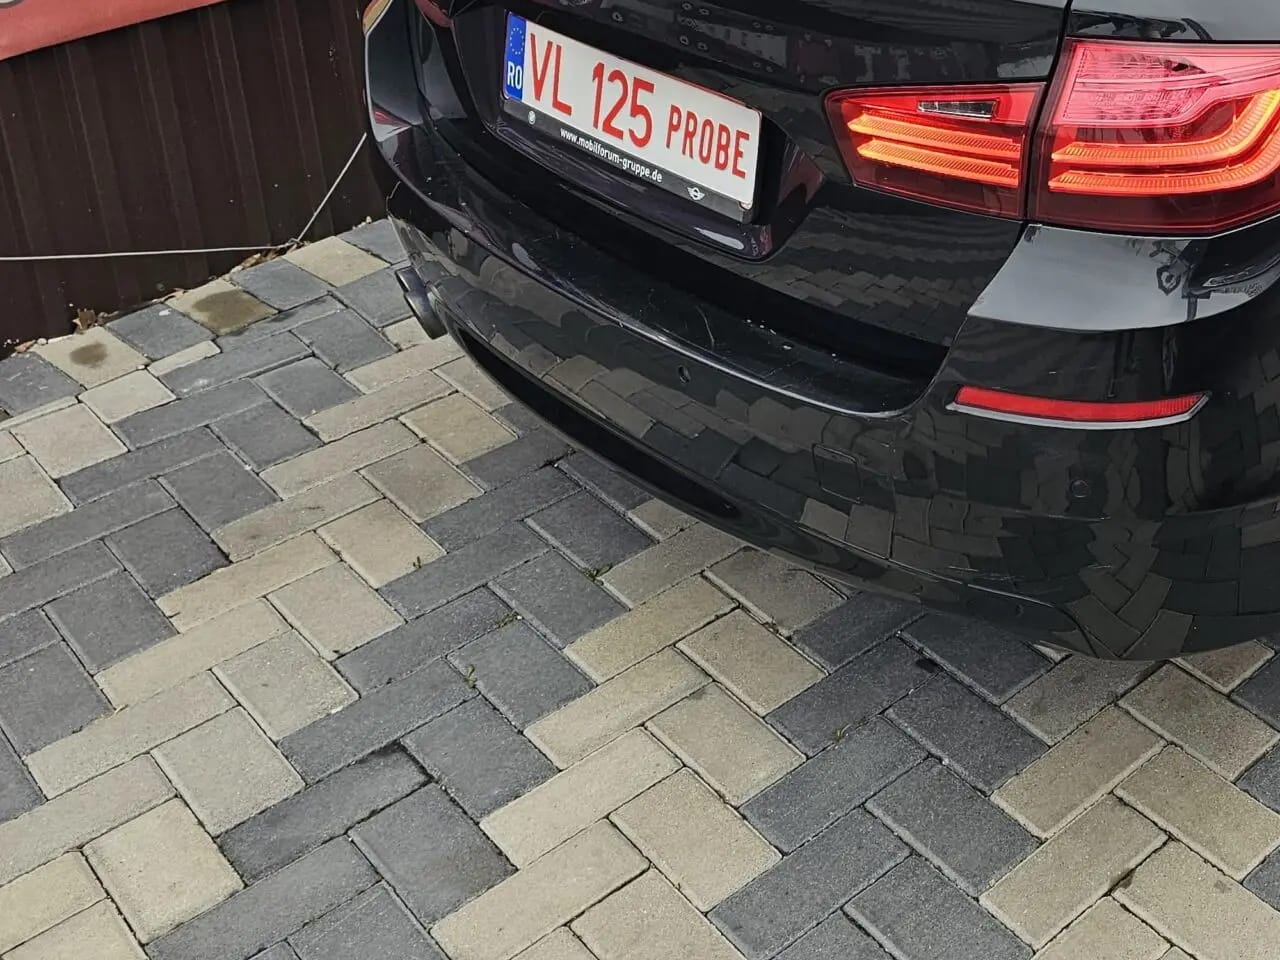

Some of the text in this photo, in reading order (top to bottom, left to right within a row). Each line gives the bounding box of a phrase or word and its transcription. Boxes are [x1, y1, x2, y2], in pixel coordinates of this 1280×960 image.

[507, 61, 523, 90] RO
[530, 32, 751, 180] VL 125 PROBE
[560, 127, 663, 183] www.mobilforum-gruppe.de
